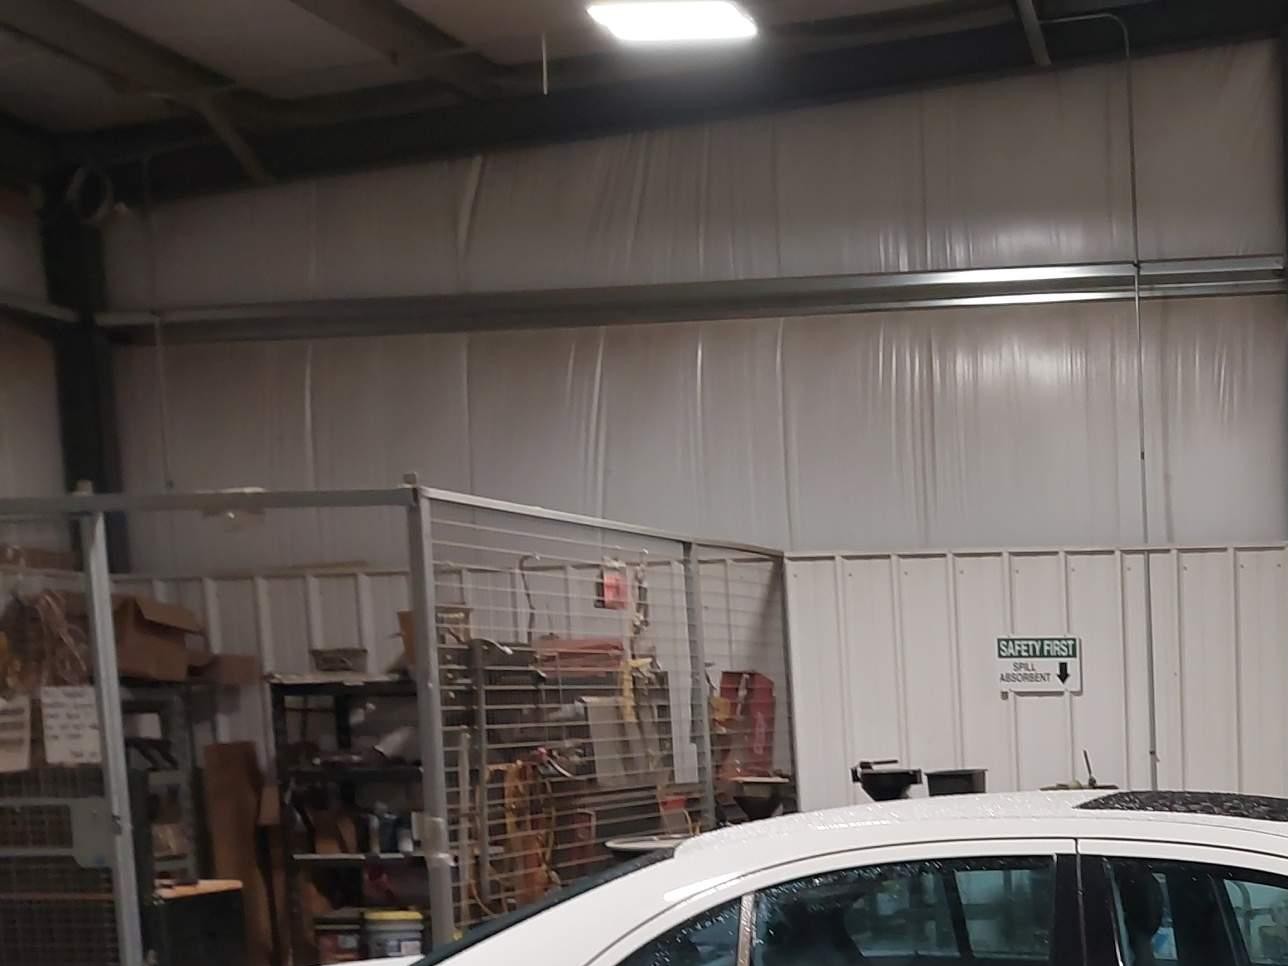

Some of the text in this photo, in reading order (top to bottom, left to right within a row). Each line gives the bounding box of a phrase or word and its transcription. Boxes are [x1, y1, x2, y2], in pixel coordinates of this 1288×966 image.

[1000, 641, 1074, 656] SAFETY FIRST
[1013, 662, 1036, 672] SPILL
[1000, 673, 1051, 683] ABSORBENT
